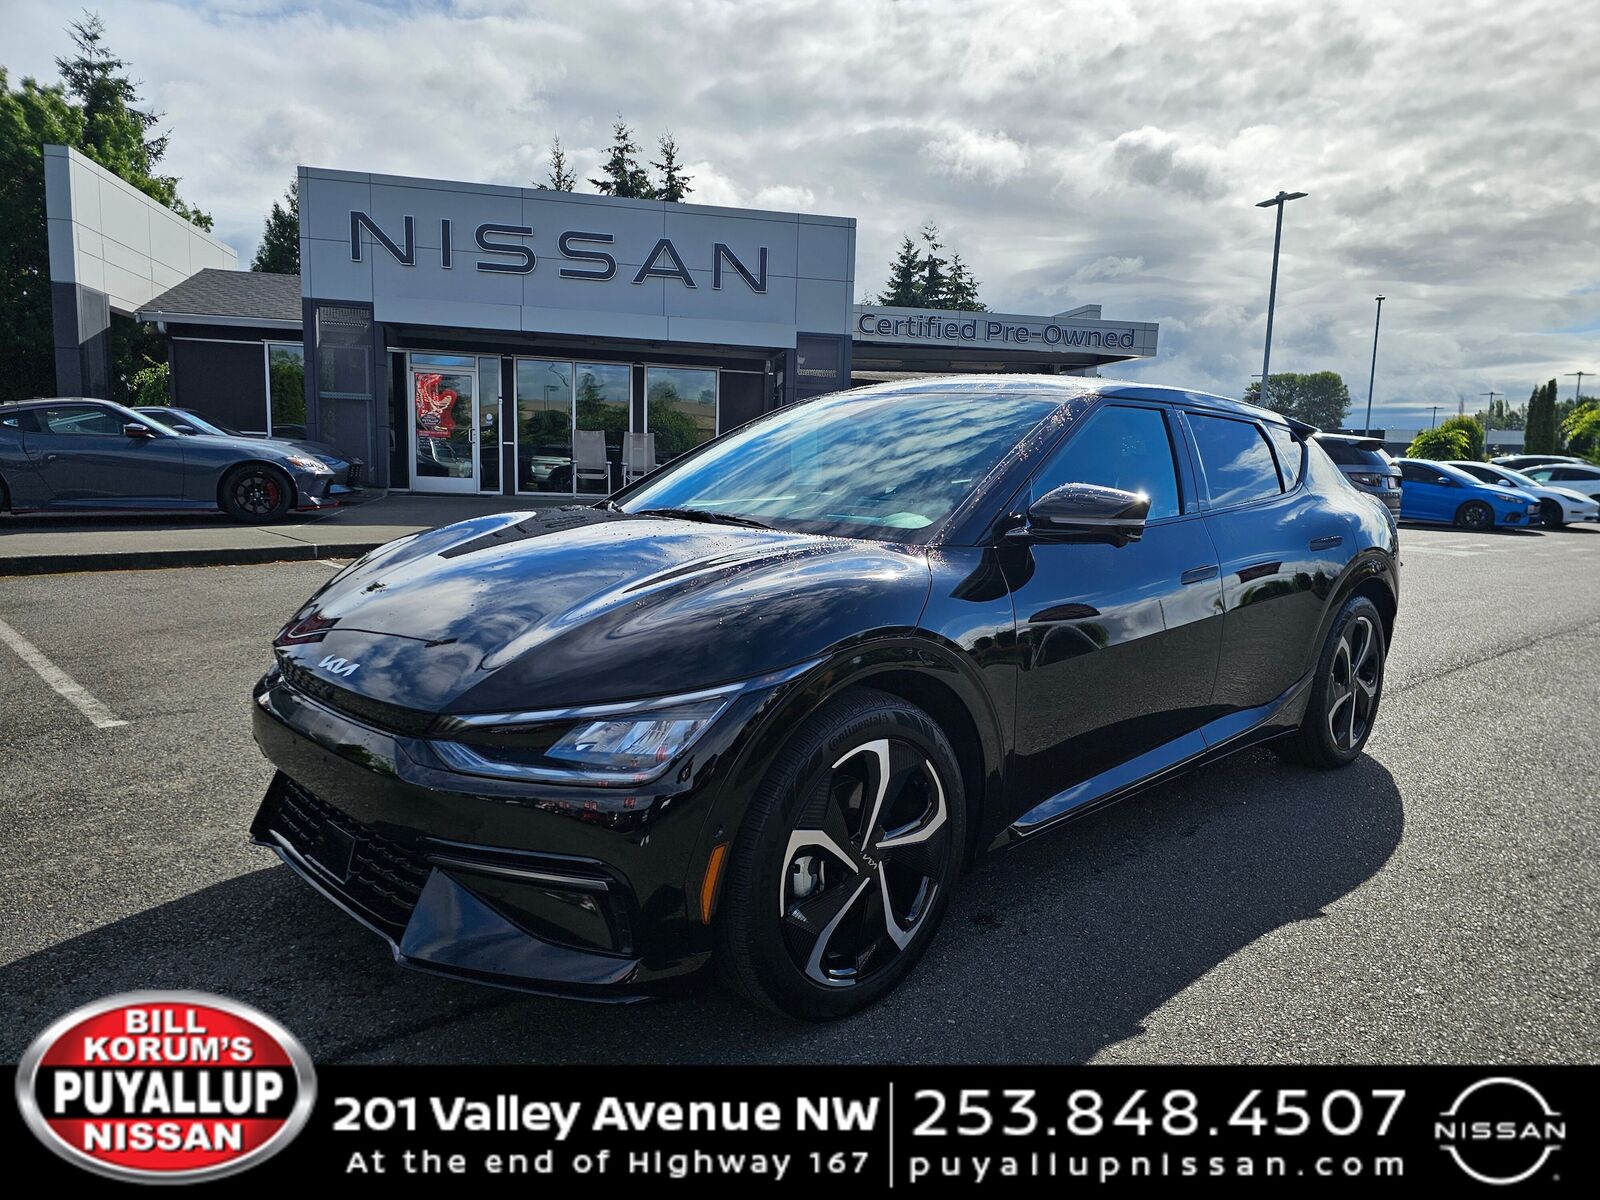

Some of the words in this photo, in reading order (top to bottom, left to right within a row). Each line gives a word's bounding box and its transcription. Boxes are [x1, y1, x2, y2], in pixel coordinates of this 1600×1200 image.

[349, 209, 769, 294] NISSAN
[857, 312, 977, 341] Certified
[985, 320, 1136, 349] Pre-Owned
[318, 653, 360, 677] KIA
